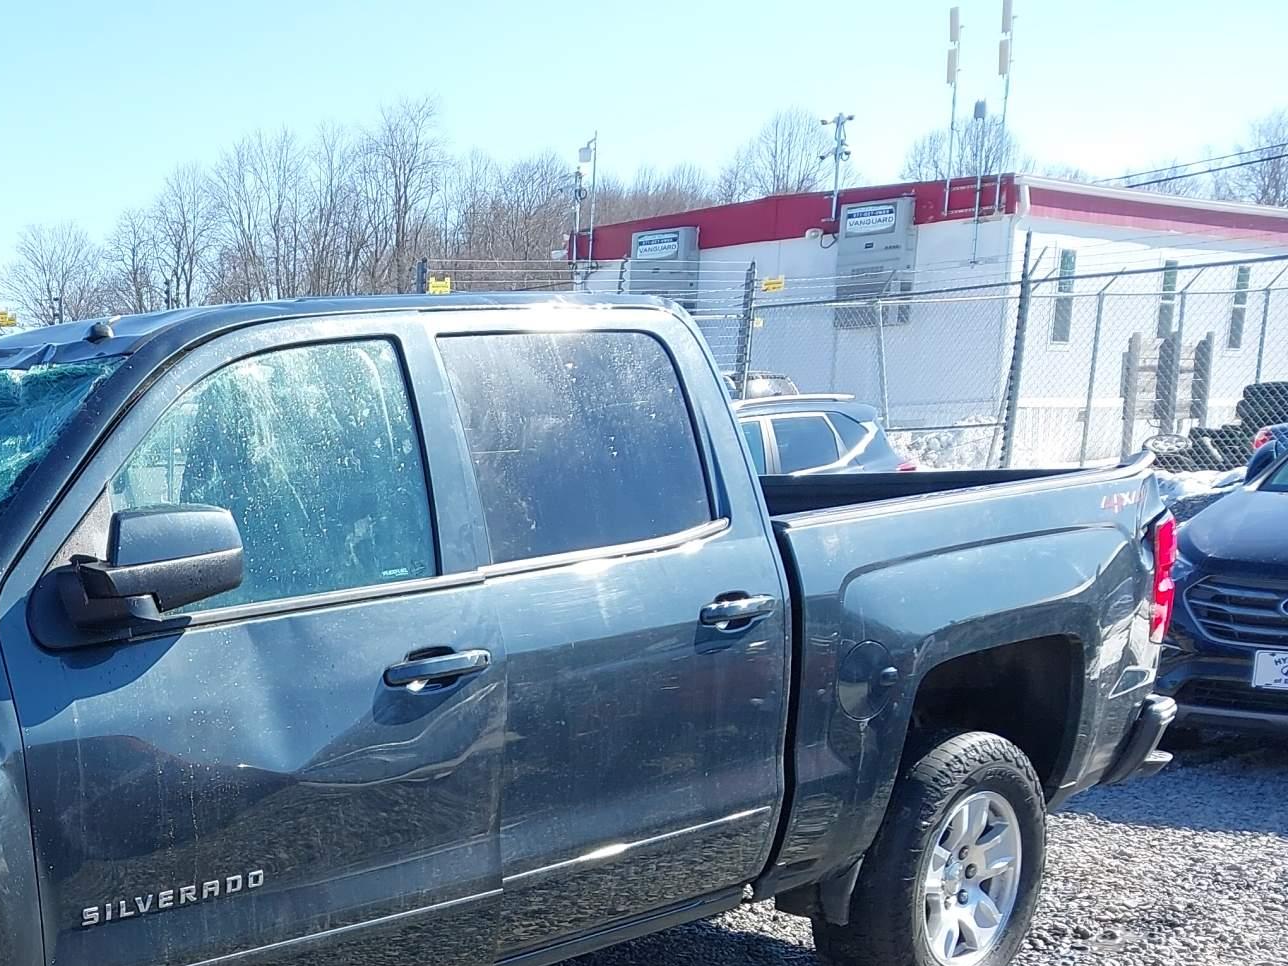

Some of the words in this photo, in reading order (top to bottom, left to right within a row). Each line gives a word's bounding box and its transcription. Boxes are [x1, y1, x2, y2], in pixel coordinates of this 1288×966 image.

[848, 215, 894, 227] VANGUARD
[639, 243, 677, 254] VANGUARD
[81, 869, 264, 927] SILVERADO
